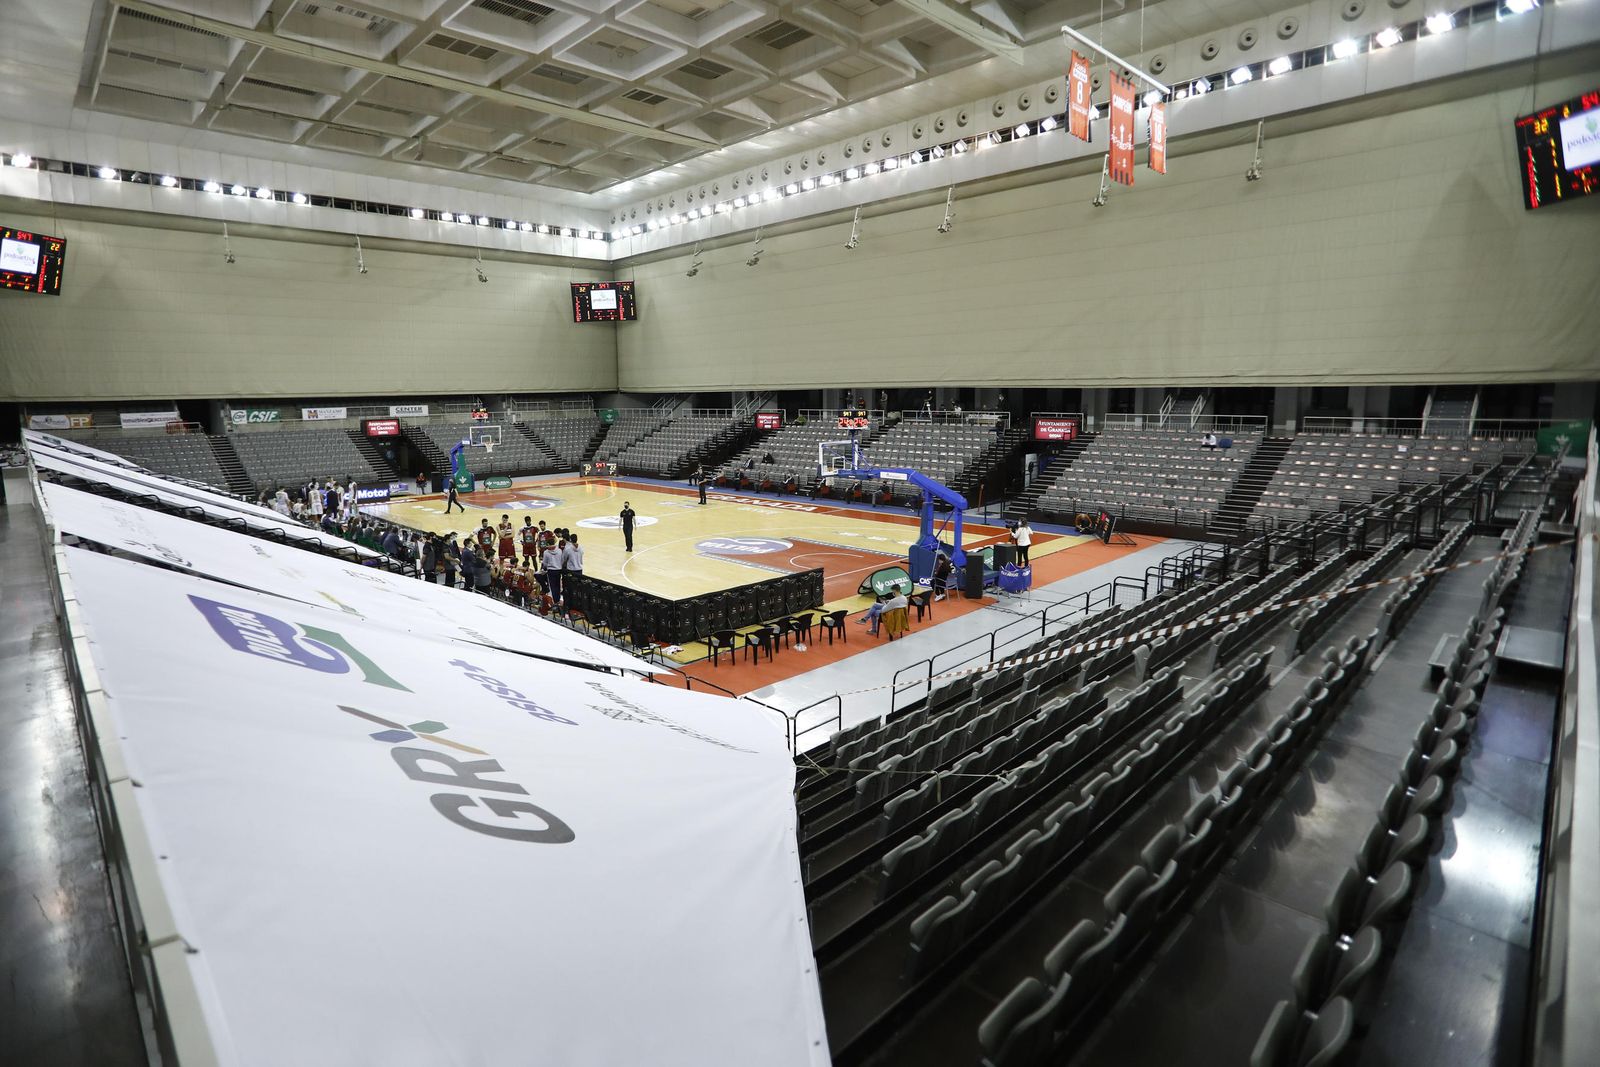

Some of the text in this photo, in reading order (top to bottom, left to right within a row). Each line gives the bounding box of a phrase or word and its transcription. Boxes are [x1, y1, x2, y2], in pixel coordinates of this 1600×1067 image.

[248, 410, 278, 423] CSIF
[358, 489, 388, 499] Motor
[217, 606, 307, 666] PULEVA
